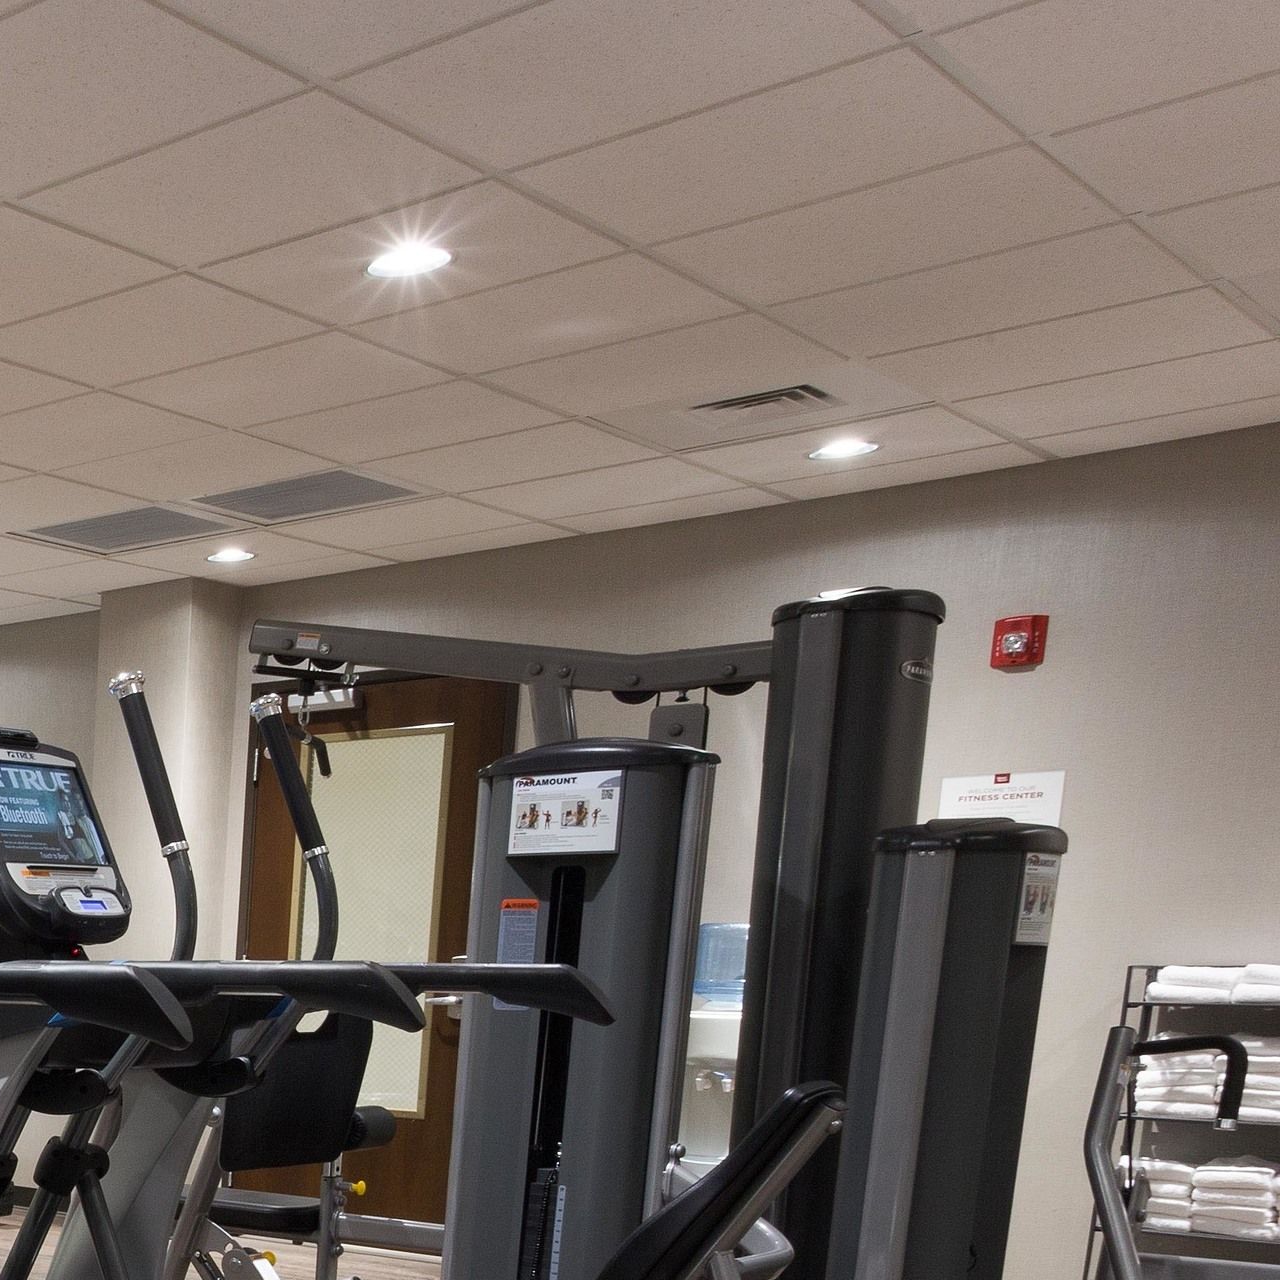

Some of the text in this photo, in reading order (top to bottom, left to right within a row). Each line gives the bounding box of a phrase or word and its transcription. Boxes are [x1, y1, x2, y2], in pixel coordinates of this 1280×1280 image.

[0, 767, 71, 793] TRUE
[518, 776, 578, 788] PARAMOUNT
[958, 791, 1044, 803] FITNESS CENTER
